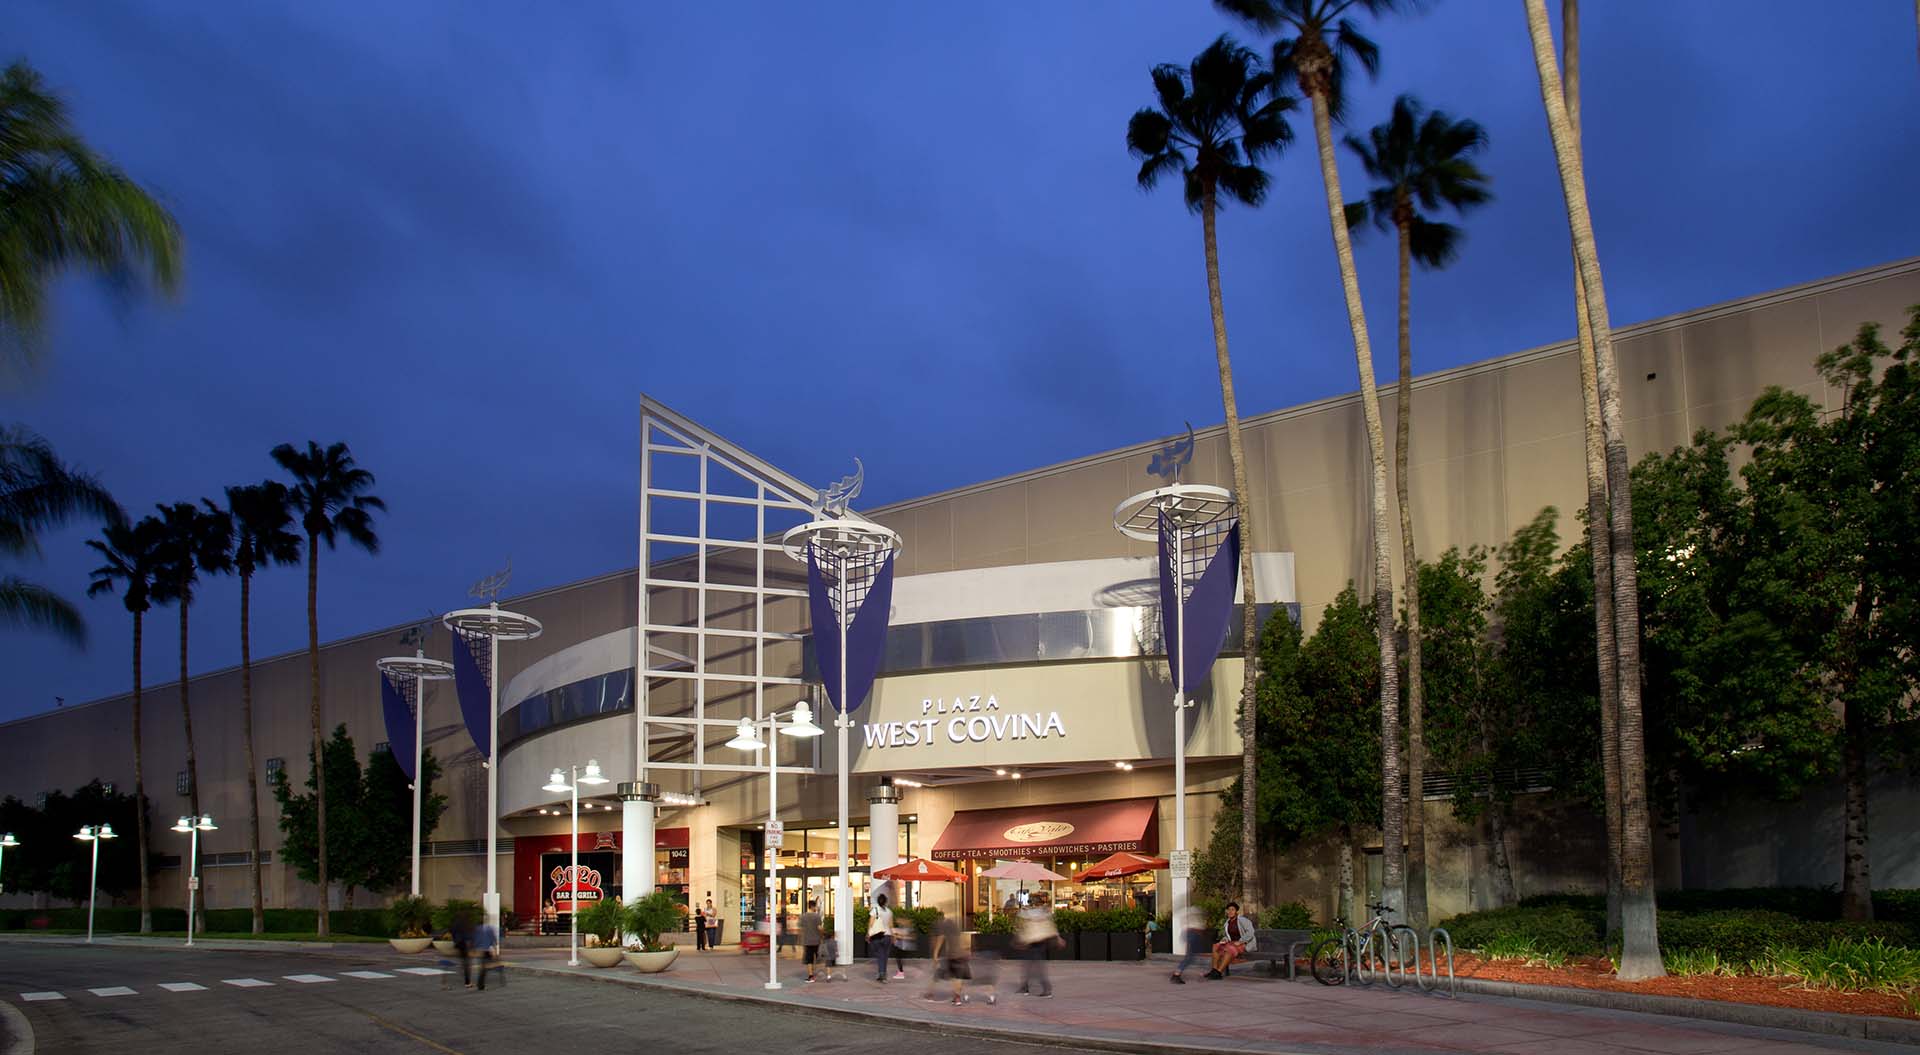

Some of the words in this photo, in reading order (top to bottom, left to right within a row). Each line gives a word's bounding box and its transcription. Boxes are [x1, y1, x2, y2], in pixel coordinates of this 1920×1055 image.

[922, 694, 1000, 716] PLAZA
[863, 718, 940, 749] WEST
[947, 711, 1066, 743] COVINA
[671, 850, 688, 858] 1042
[934, 850, 961, 859] COFFEE
[967, 849, 982, 858] TEA
[988, 847, 1031, 857] SMOOTHIES
[1038, 844, 1089, 855] SANDWICHES
[1097, 842, 1137, 852] PASTRIES
[556, 891, 570, 899] BAR
[577, 891, 598, 899] GRILL
